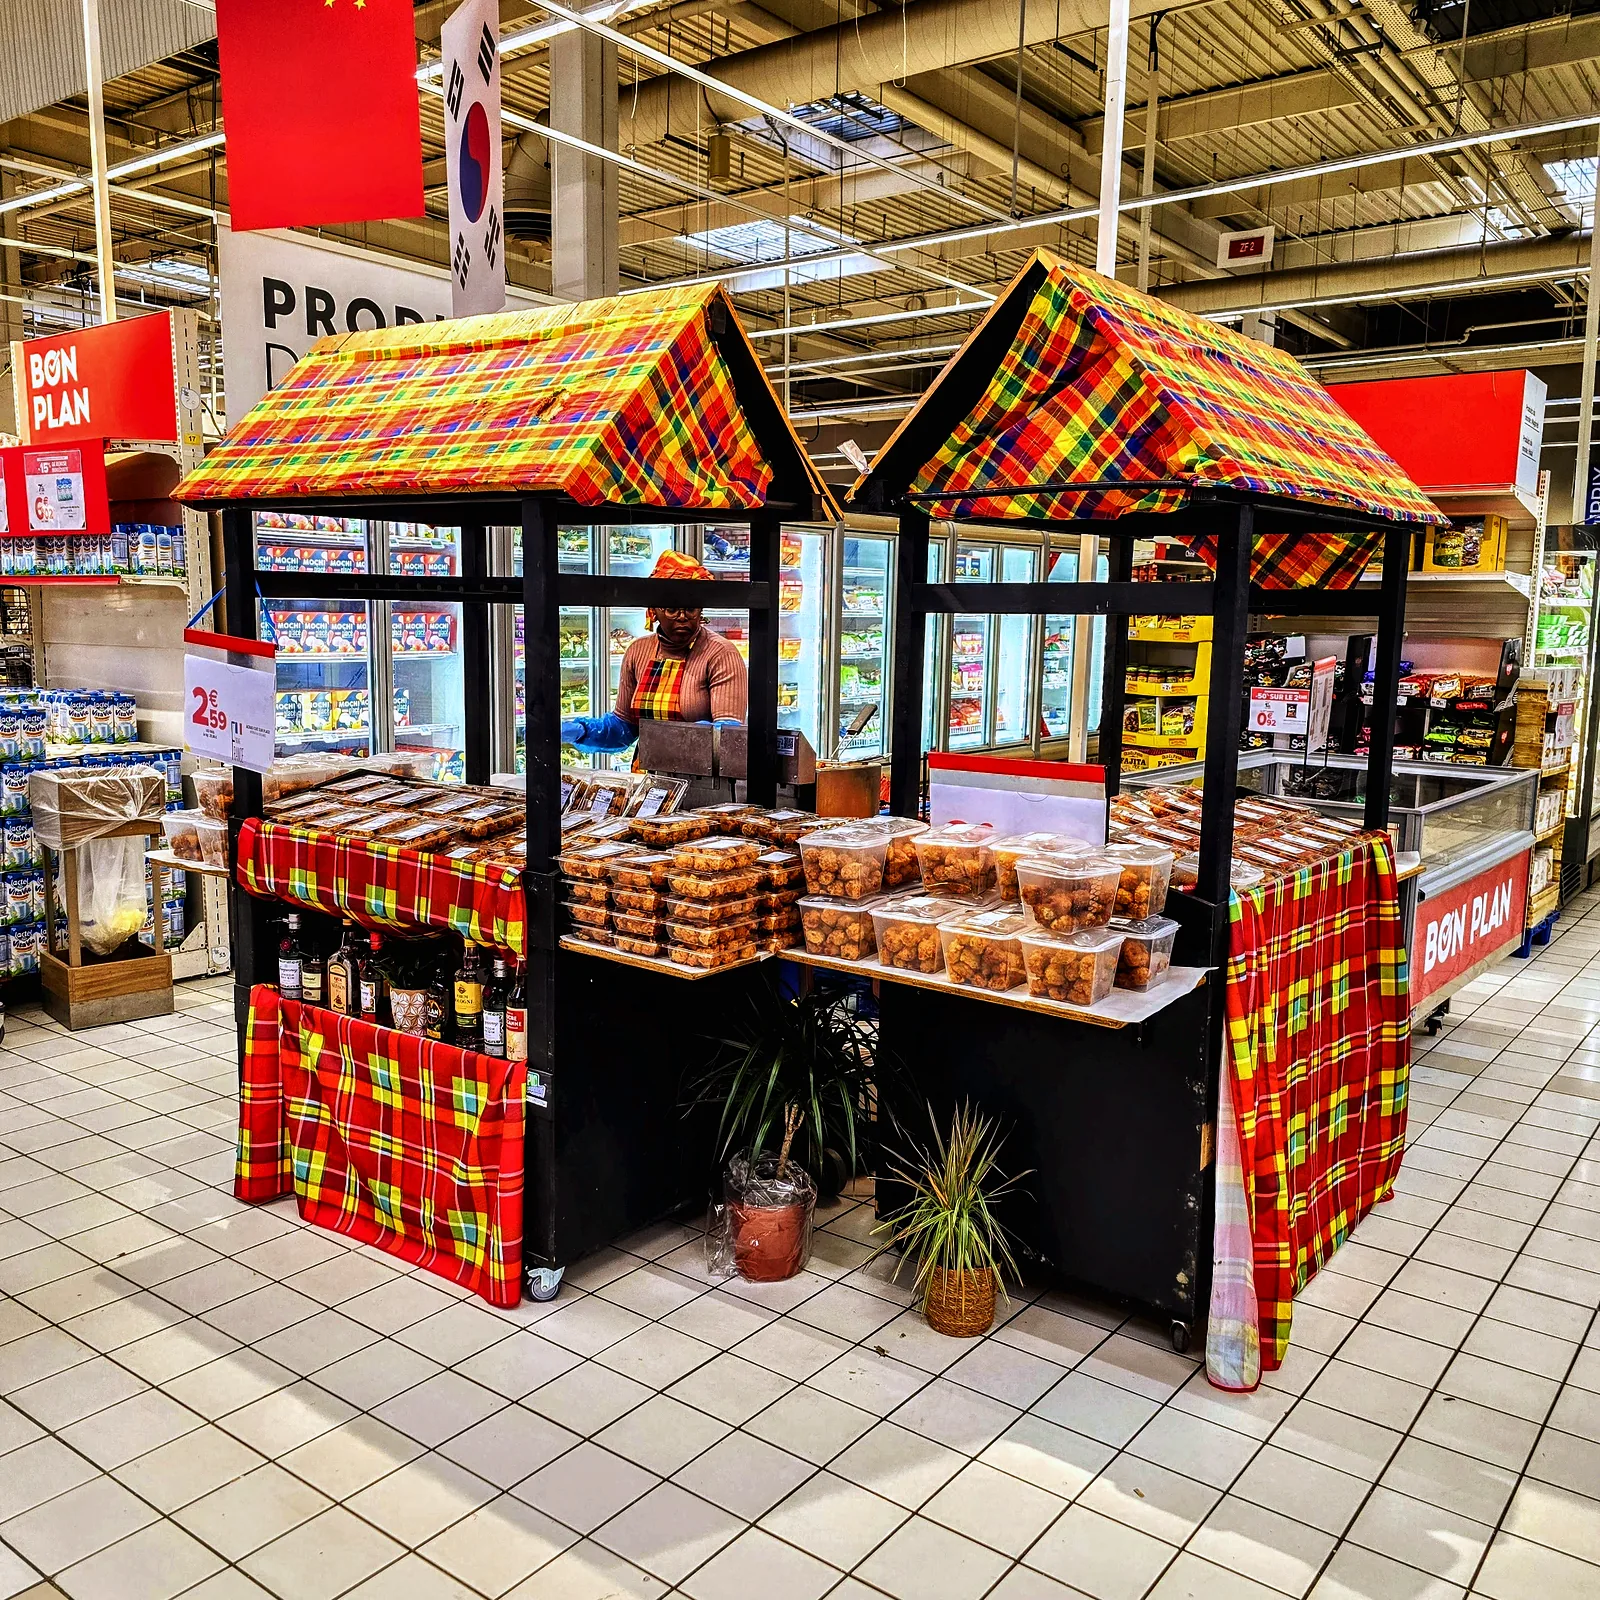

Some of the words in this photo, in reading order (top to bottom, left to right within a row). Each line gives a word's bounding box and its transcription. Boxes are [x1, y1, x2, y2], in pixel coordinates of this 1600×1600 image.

[1240, 242, 1249, 252] ZF
[1250, 241, 1254, 251] 2
[262, 277, 446, 337] PRO
[30, 346, 78, 390] BON
[32, 387, 90, 431] PLAN
[69, 709, 89, 717] VitaVie
[92, 709, 112, 717] VitaVie
[115, 709, 135, 717] VitaVie
[23, 724, 45, 733] VitaVie
[5, 778, 28, 787] VitaVie
[1424, 904, 1467, 975] BON
[1469, 877, 1513, 945] PLAN
